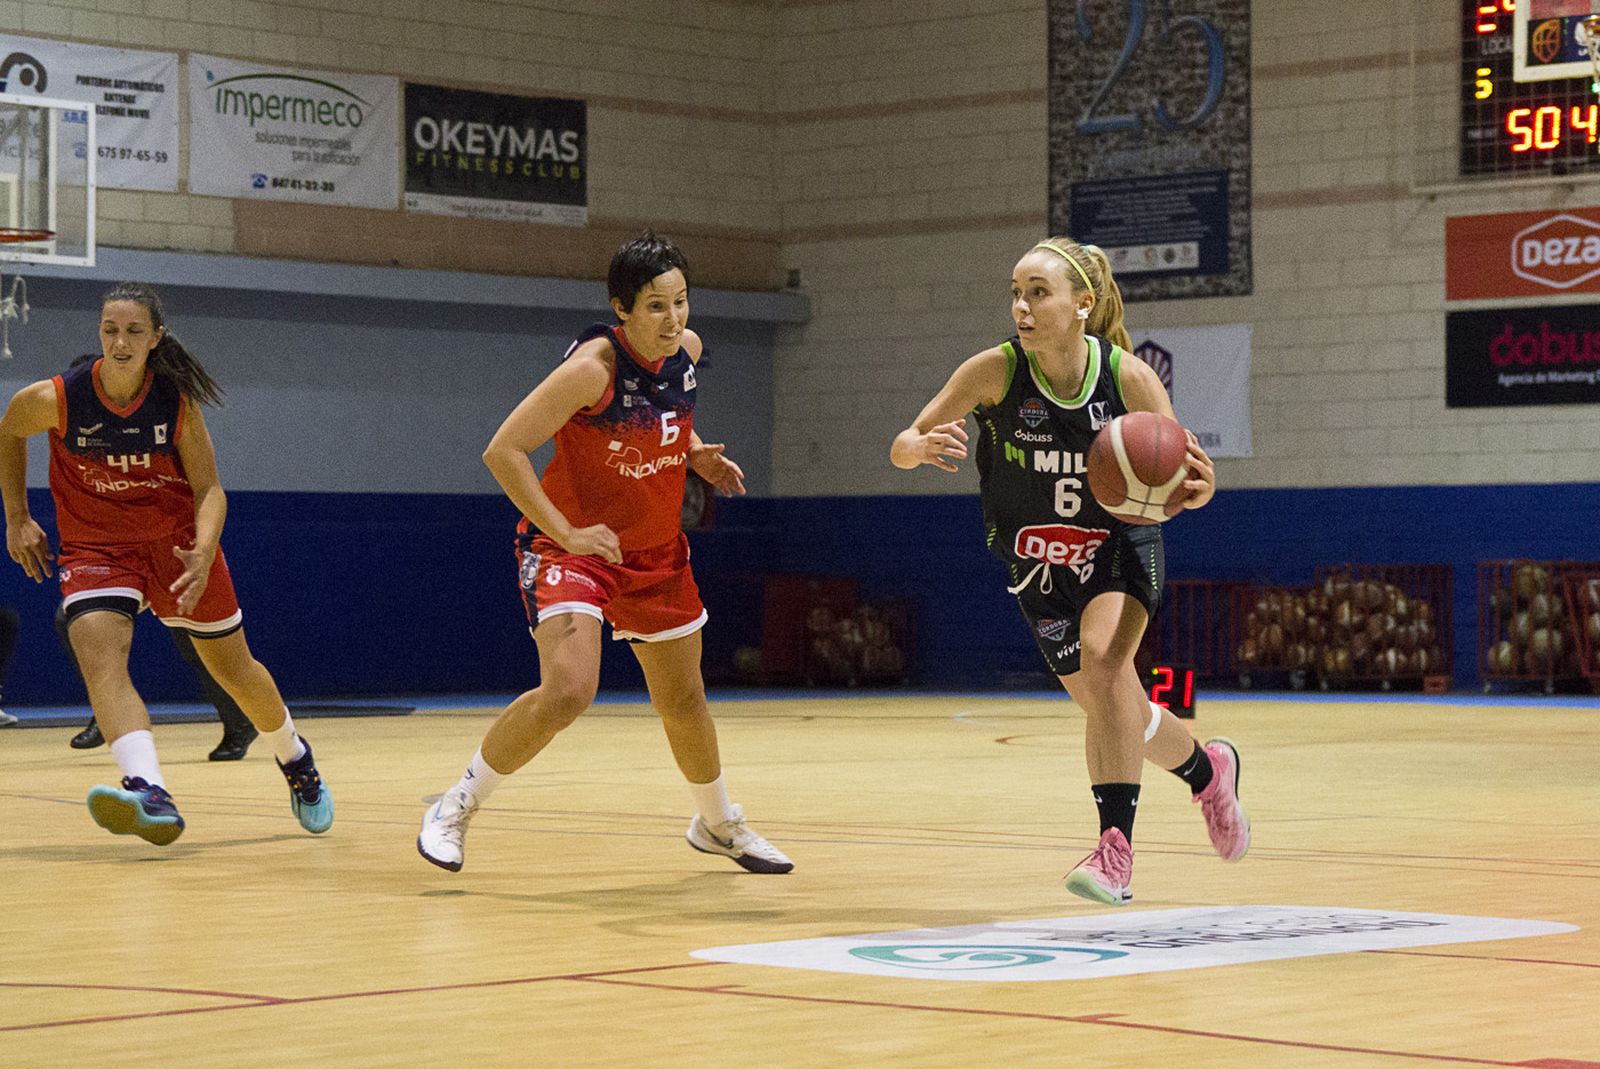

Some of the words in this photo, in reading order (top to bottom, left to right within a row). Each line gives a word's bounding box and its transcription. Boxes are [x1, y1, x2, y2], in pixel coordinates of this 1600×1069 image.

[1475, 67, 1493, 99] 5
[215, 88, 363, 128] impermeco
[414, 116, 579, 162] OKEYMAS
[1506, 106, 1561, 151] 50
[98, 146, 117, 159] 675
[660, 410, 680, 447] 6
[1014, 429, 1053, 442] dobuss
[107, 453, 151, 473] 44
[1054, 478, 1082, 517] 6
[1151, 665, 1194, 709] 21
